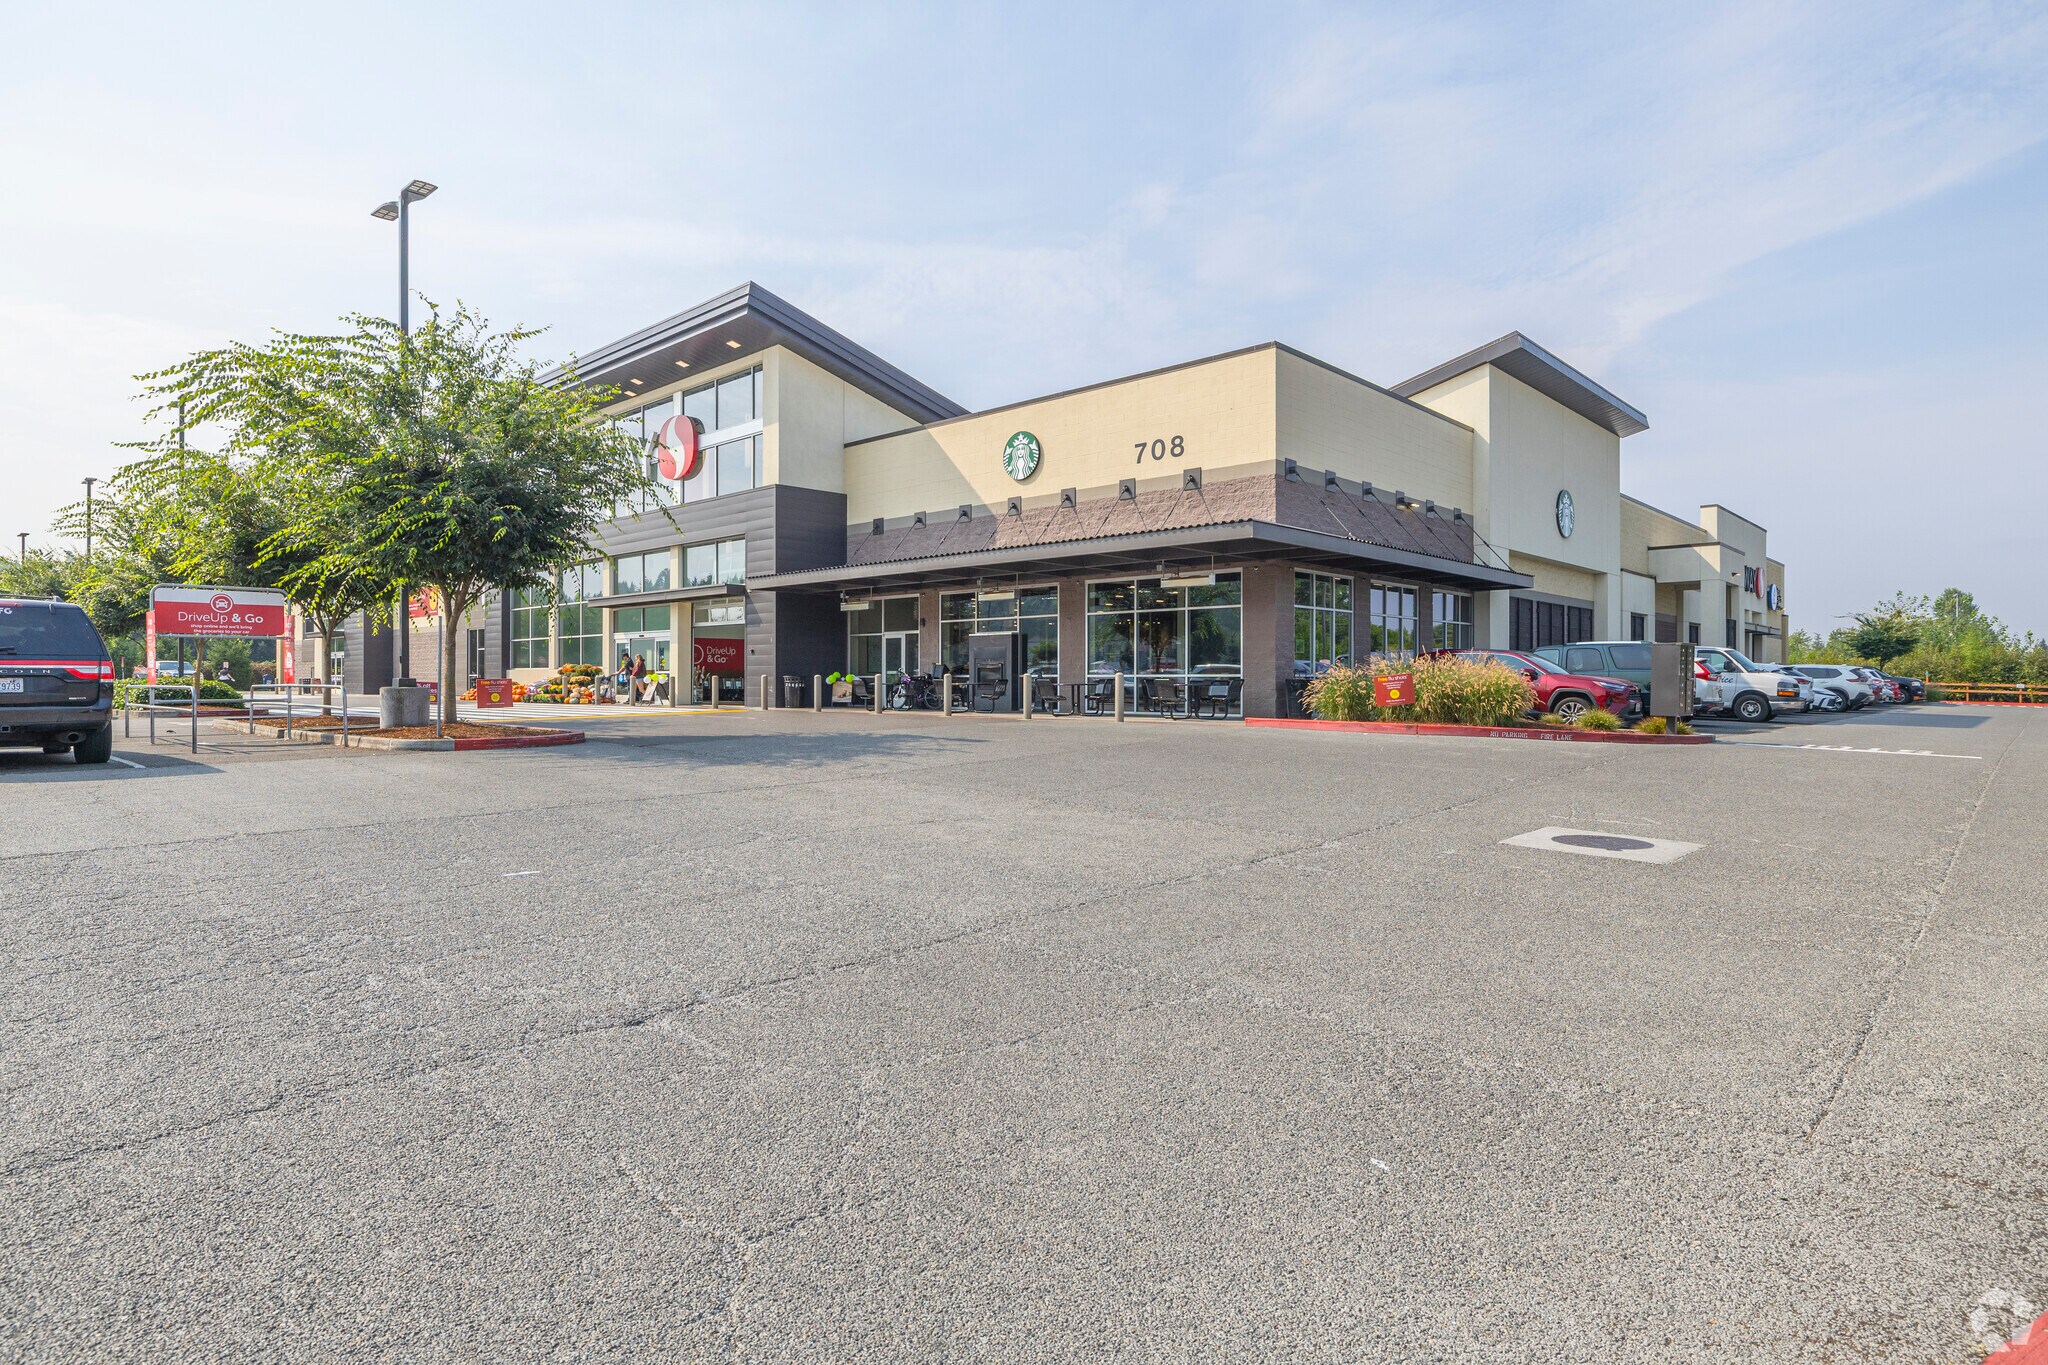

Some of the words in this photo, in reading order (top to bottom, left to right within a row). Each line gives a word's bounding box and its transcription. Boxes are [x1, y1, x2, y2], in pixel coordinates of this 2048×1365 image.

[1135, 435, 1184, 464] 708
[178, 611, 228, 624] DriveUp
[231, 613, 241, 623] &
[245, 613, 264, 623] Go
[706, 645, 736, 656] DriveUp
[0, 681, 21, 691] 9739
[1490, 730, 1499, 738] NO
[1501, 731, 1528, 739] PARKING
